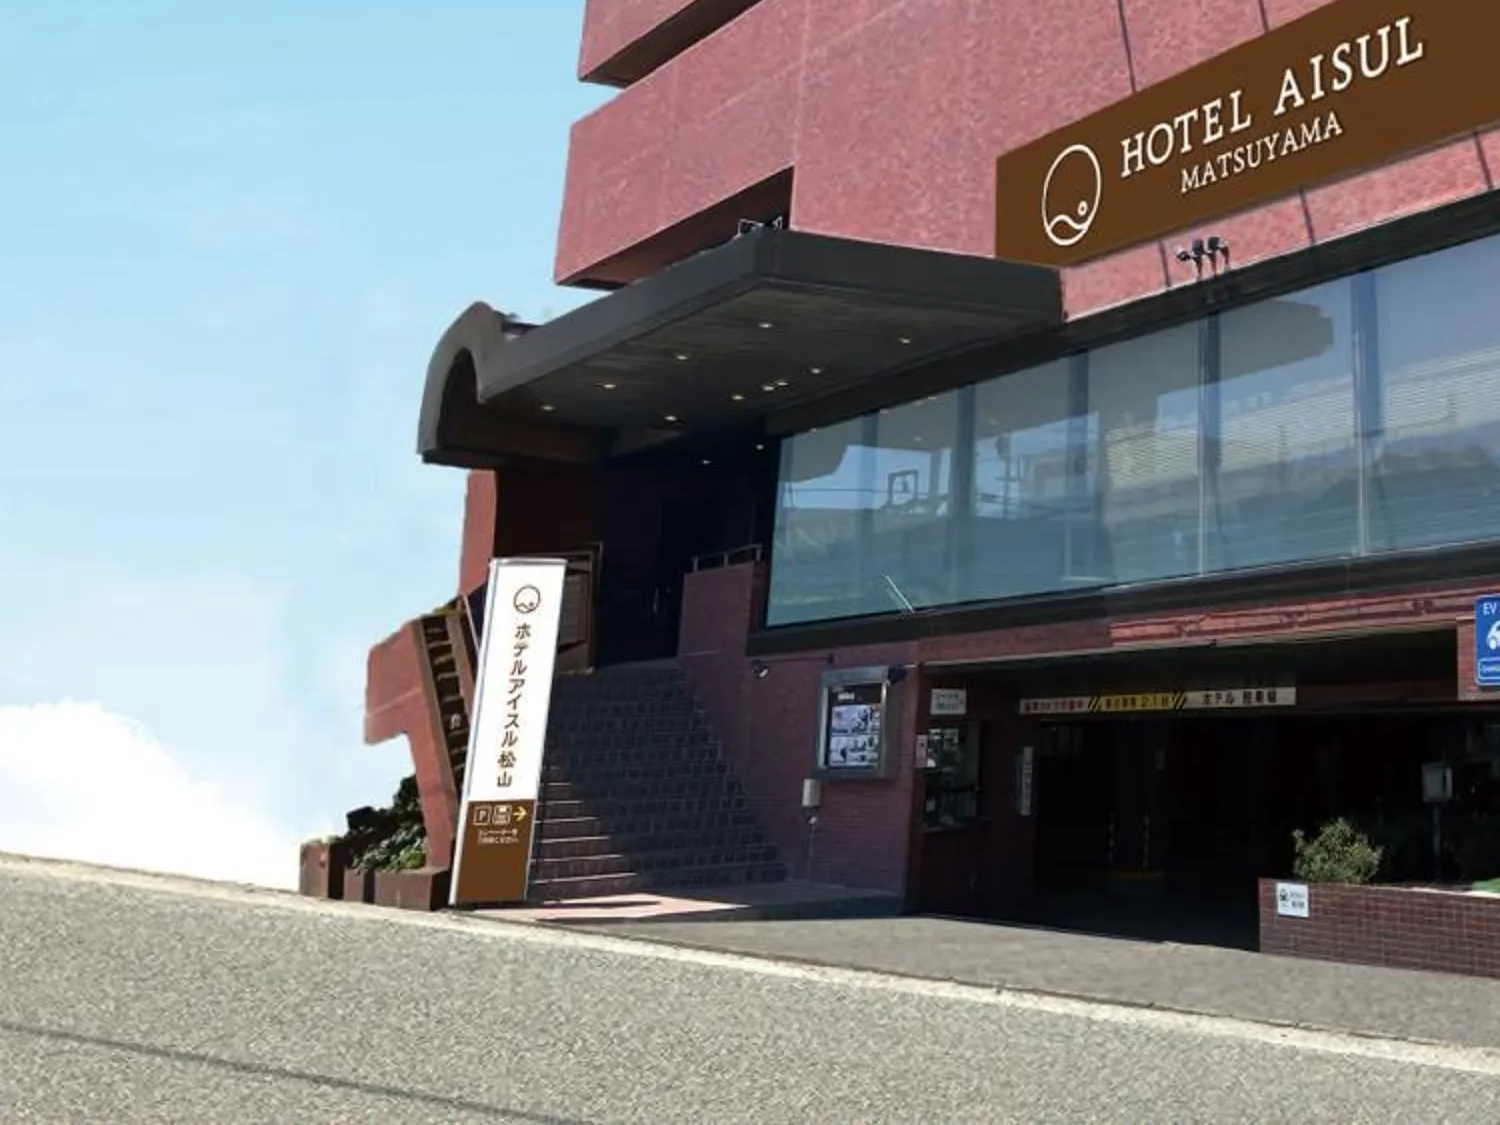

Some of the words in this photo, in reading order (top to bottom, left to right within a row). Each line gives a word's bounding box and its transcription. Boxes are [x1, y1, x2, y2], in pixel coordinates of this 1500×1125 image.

[1120, 90, 1251, 177] HOTEL
[1273, 16, 1424, 115] AISUL
[1180, 111, 1343, 193] MATSUYAMA
[1483, 602, 1497, 615] EV
[497, 622, 532, 788] ホテルアイスル松山
